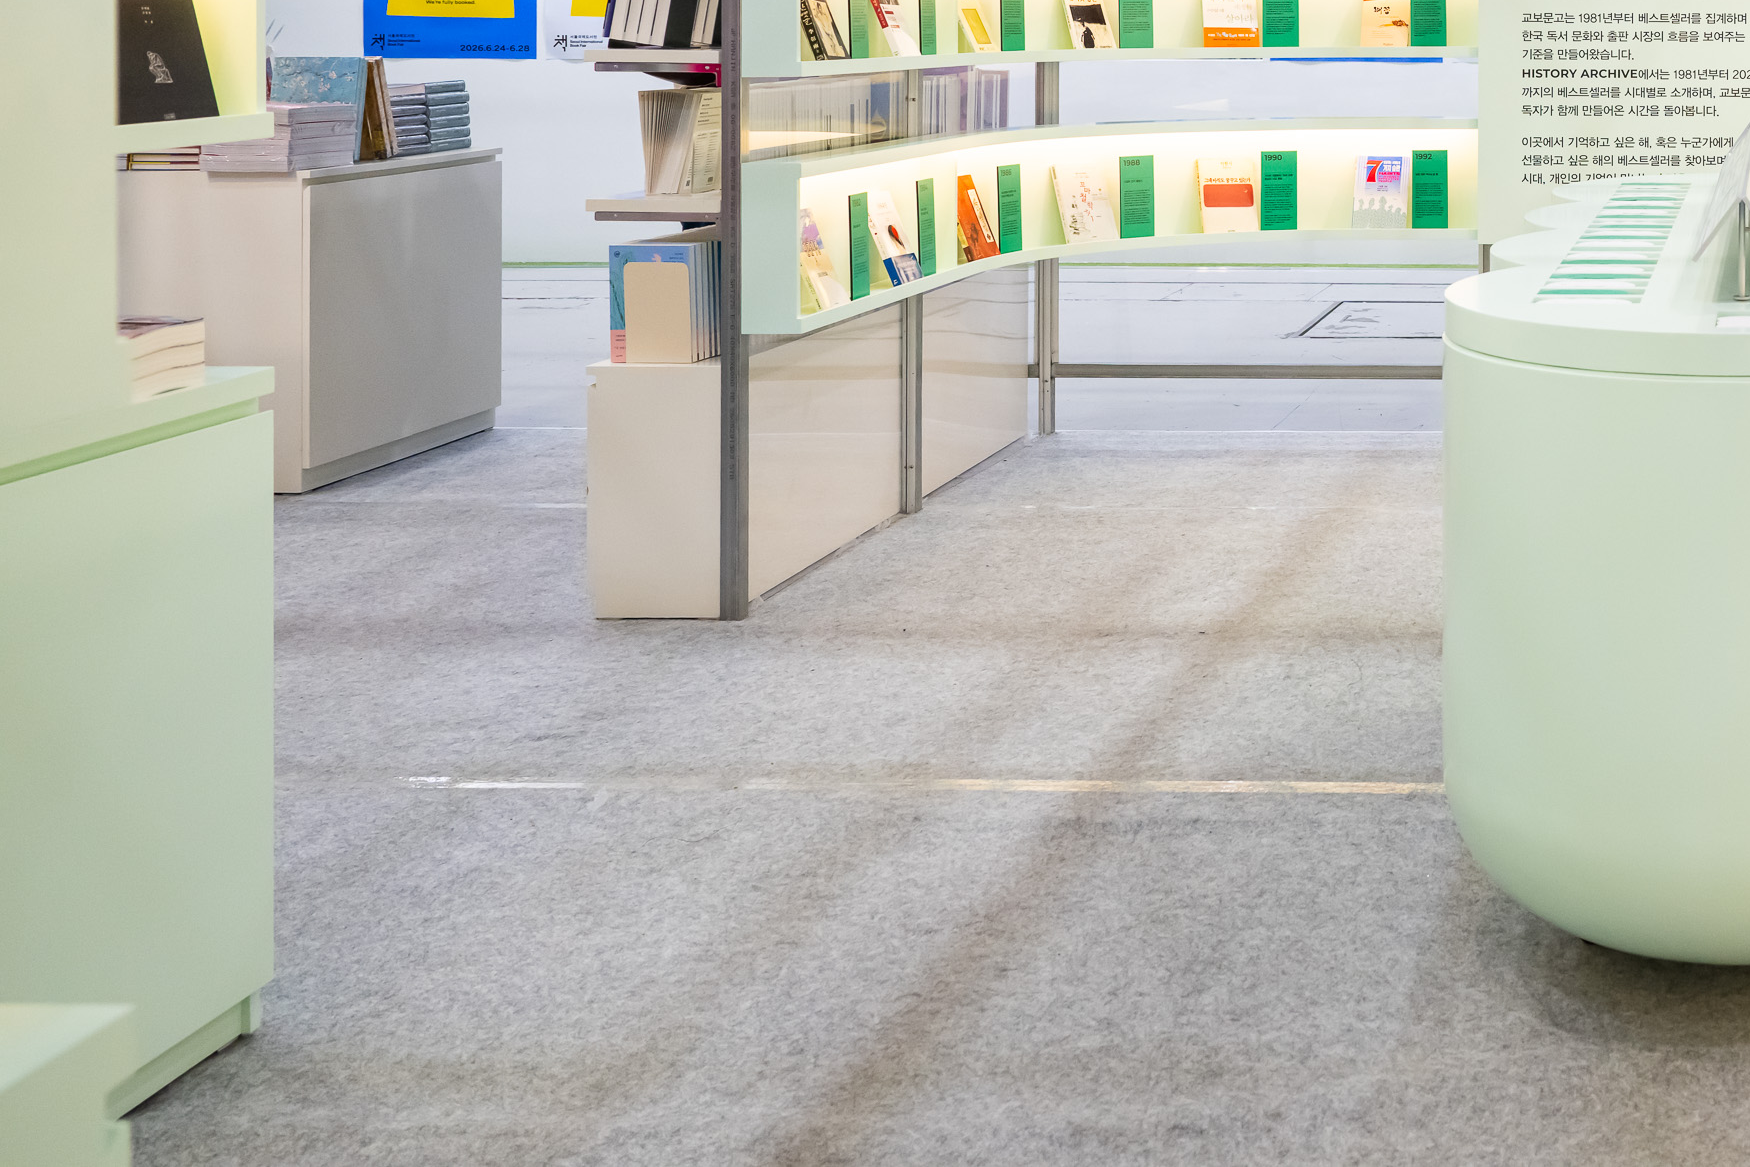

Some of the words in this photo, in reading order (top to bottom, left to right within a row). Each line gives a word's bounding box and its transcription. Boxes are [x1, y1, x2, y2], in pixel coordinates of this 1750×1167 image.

[1522, 13, 1575, 23] 교보문고는
[1579, 13, 1633, 24] 1981년부터
[1638, 13, 1701, 24] 베스트셀러를
[1706, 13, 1747, 24] 집계하며
[1522, 30, 1543, 41] 한국
[1547, 31, 1567, 42] 독서
[1572, 31, 1604, 42] 문화와
[1607, 31, 1629, 42] 출판
[1632, 31, 1663, 42] 시장의
[1668, 31, 1699, 42] 흐름을
[1703, 31, 1745, 42] 보여주는
[460, 44, 530, 52] 2026.6.24-6.28
[553, 34, 568, 52] 책
[1523, 49, 1554, 60] 기준을
[1558, 49, 1634, 60] 만들어왔습니다.
[1523, 69, 1577, 78] HISTORY
[1581, 69, 1670, 80] ARCHIVE에서는
[1674, 69, 1728, 80] 1981년부터
[1522, 87, 1553, 98] 까지의
[1558, 87, 1621, 98] 베스트셀러를
[1625, 87, 1667, 98] 시대별로
[1670, 87, 1715, 98] 소개하며,
[1522, 105, 1554, 116] 독자가
[1557, 105, 1578, 116] 함께
[1582, 105, 1624, 116] 만들어온
[1628, 105, 1660, 116] 시간을
[1663, 105, 1719, 116] 돌아봅니다.
[1522, 137, 1563, 148] 이곳에서
[1568, 137, 1610, 148] 기억하고
[1614, 137, 1635, 148] 싶은
[1639, 137, 1652, 148] 해,
[1656, 137, 1677, 148] 혹은
[1681, 137, 1733, 148] 누군가에게
[1522, 155, 1564, 166] 선물하고
[1568, 155, 1589, 166] 싶은
[1592, 155, 1613, 166] 해의
[1618, 155, 1681, 166] 베스트셀러를
[1521, 173, 1546, 185] 시대,
